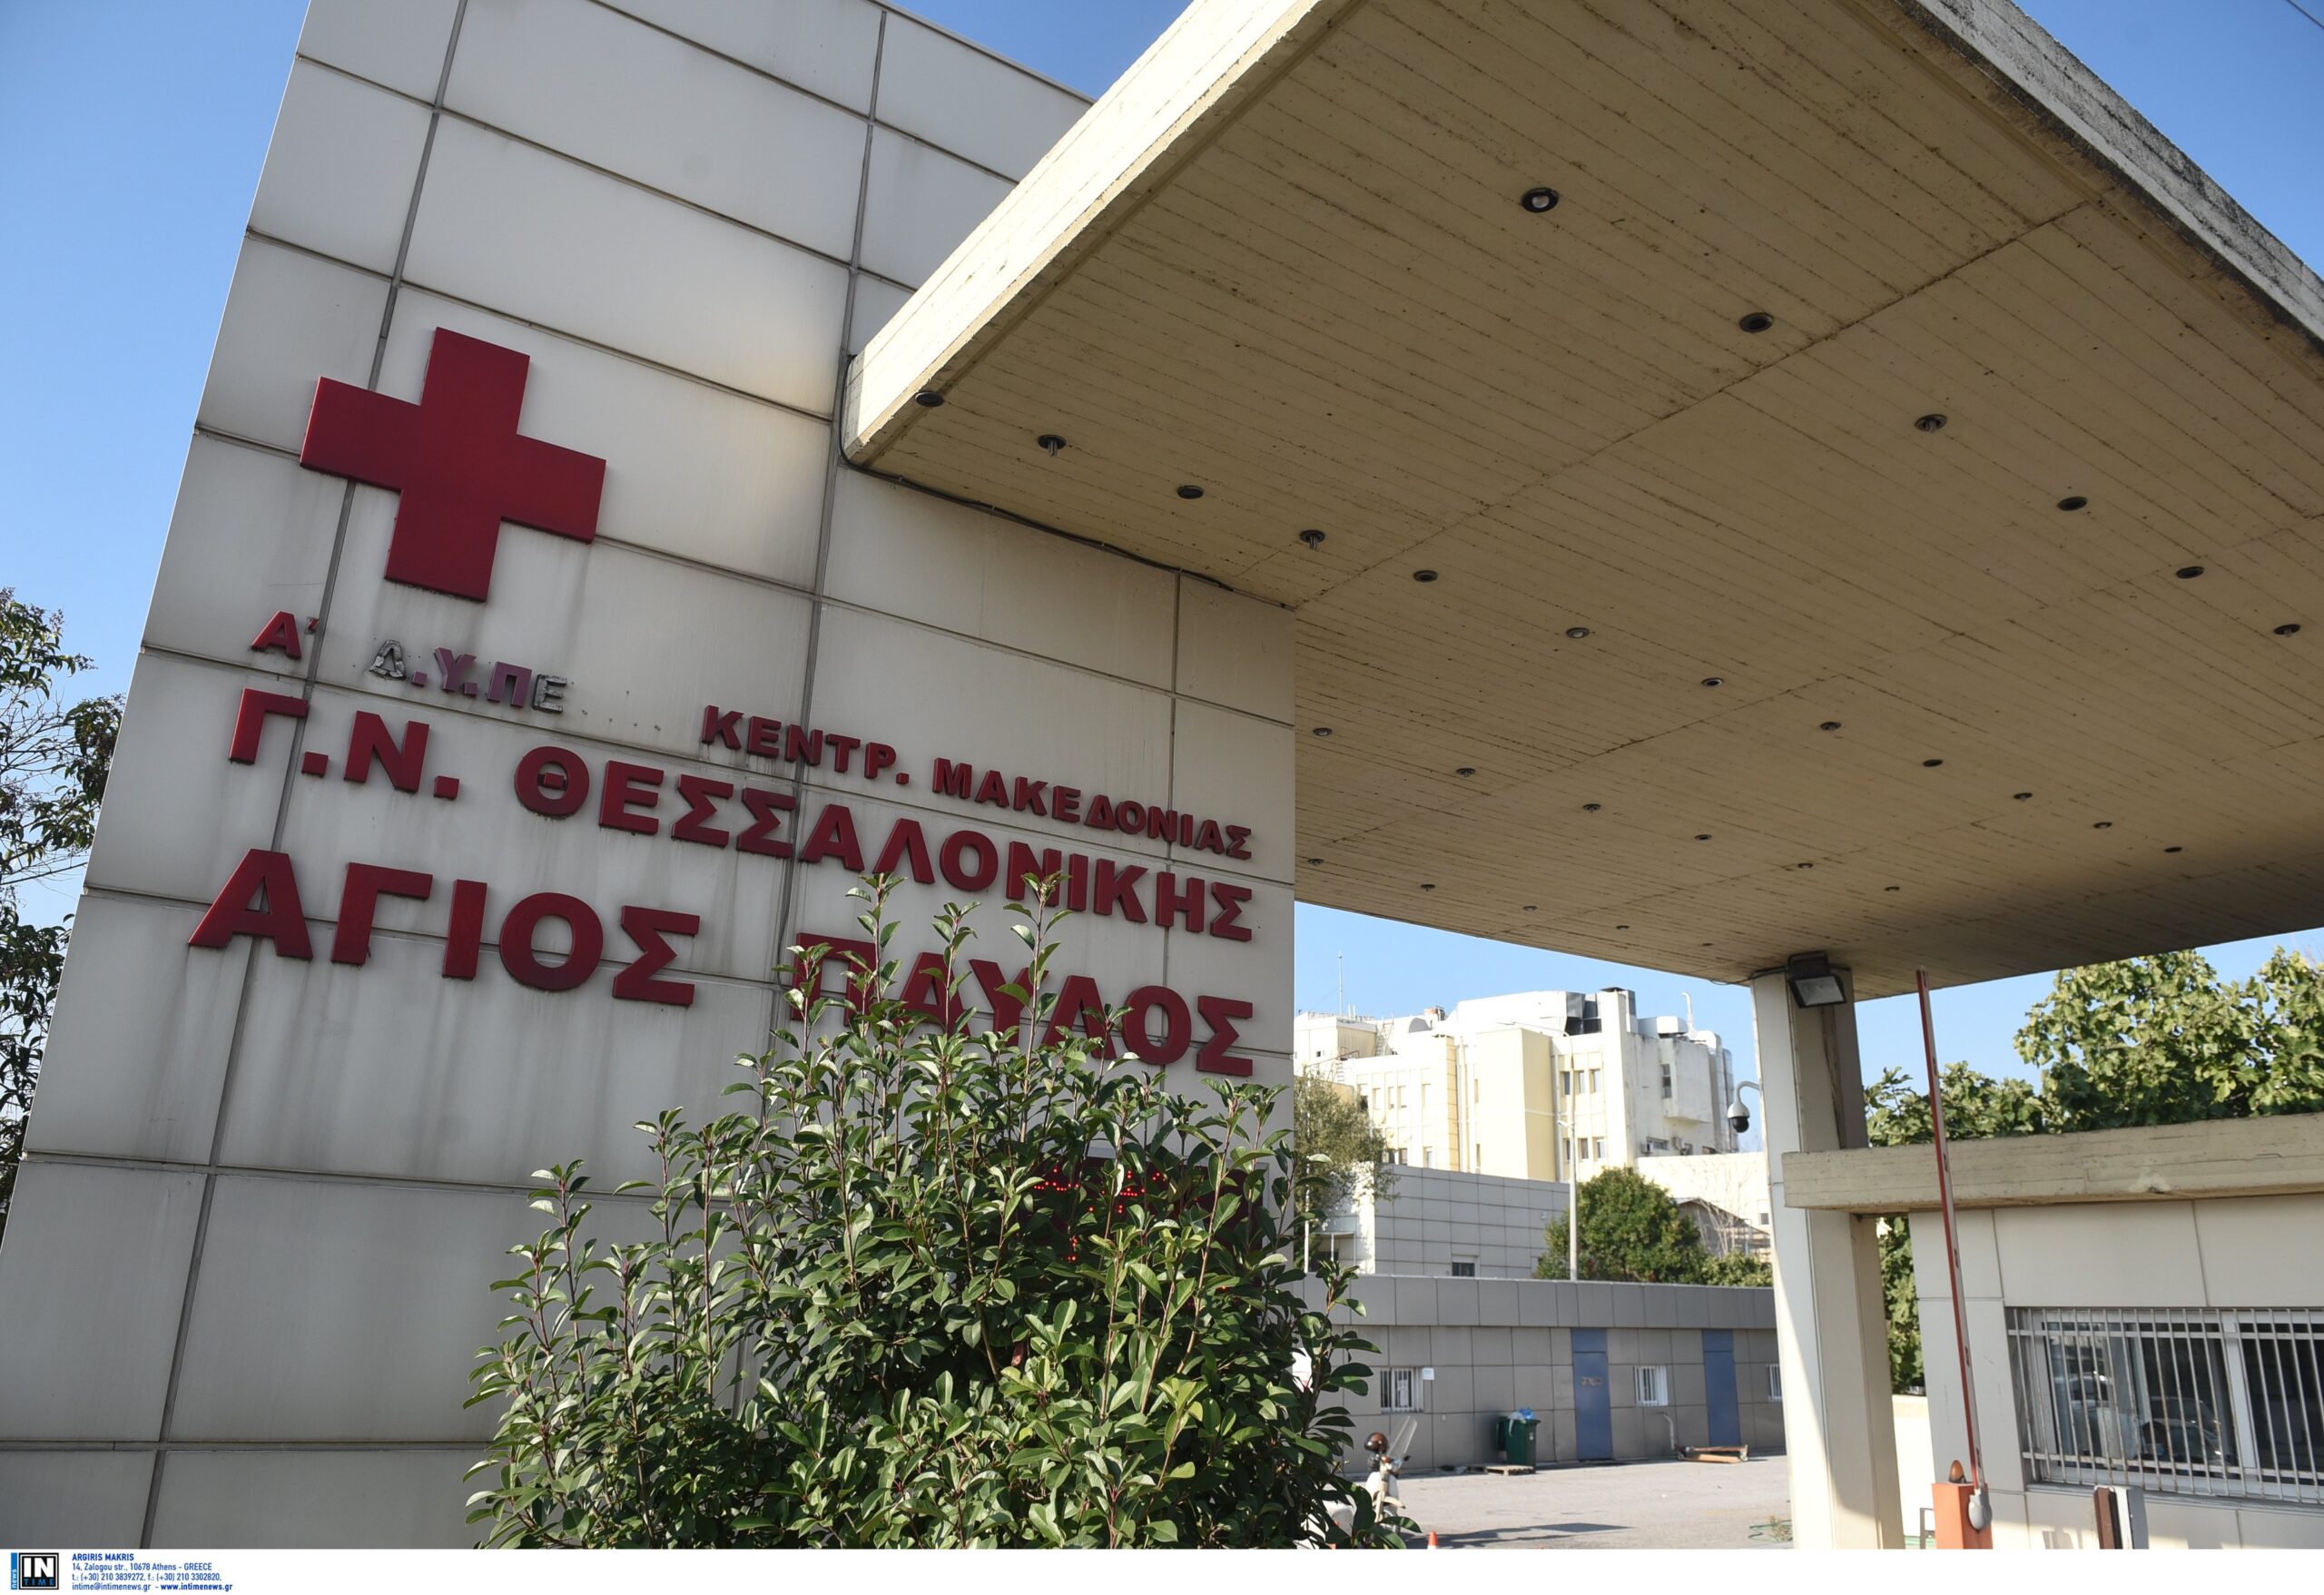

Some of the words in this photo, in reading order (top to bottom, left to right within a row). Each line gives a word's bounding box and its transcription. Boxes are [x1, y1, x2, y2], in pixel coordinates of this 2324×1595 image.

[229, 687, 460, 801] Γ.Ν.
[514, 745, 1253, 941] ΘΕΣΣΑΛΟΝΙΚΗΣ
[702, 704, 910, 785] ΚΕΝΤΡ.
[931, 757, 1252, 861] ΜΑΚΕΔΟΝΙΑΣ
[188, 848, 701, 1008] ΑΓΙΟΣ
[790, 932, 1253, 1077] ΠΑΥΛΟΣ
